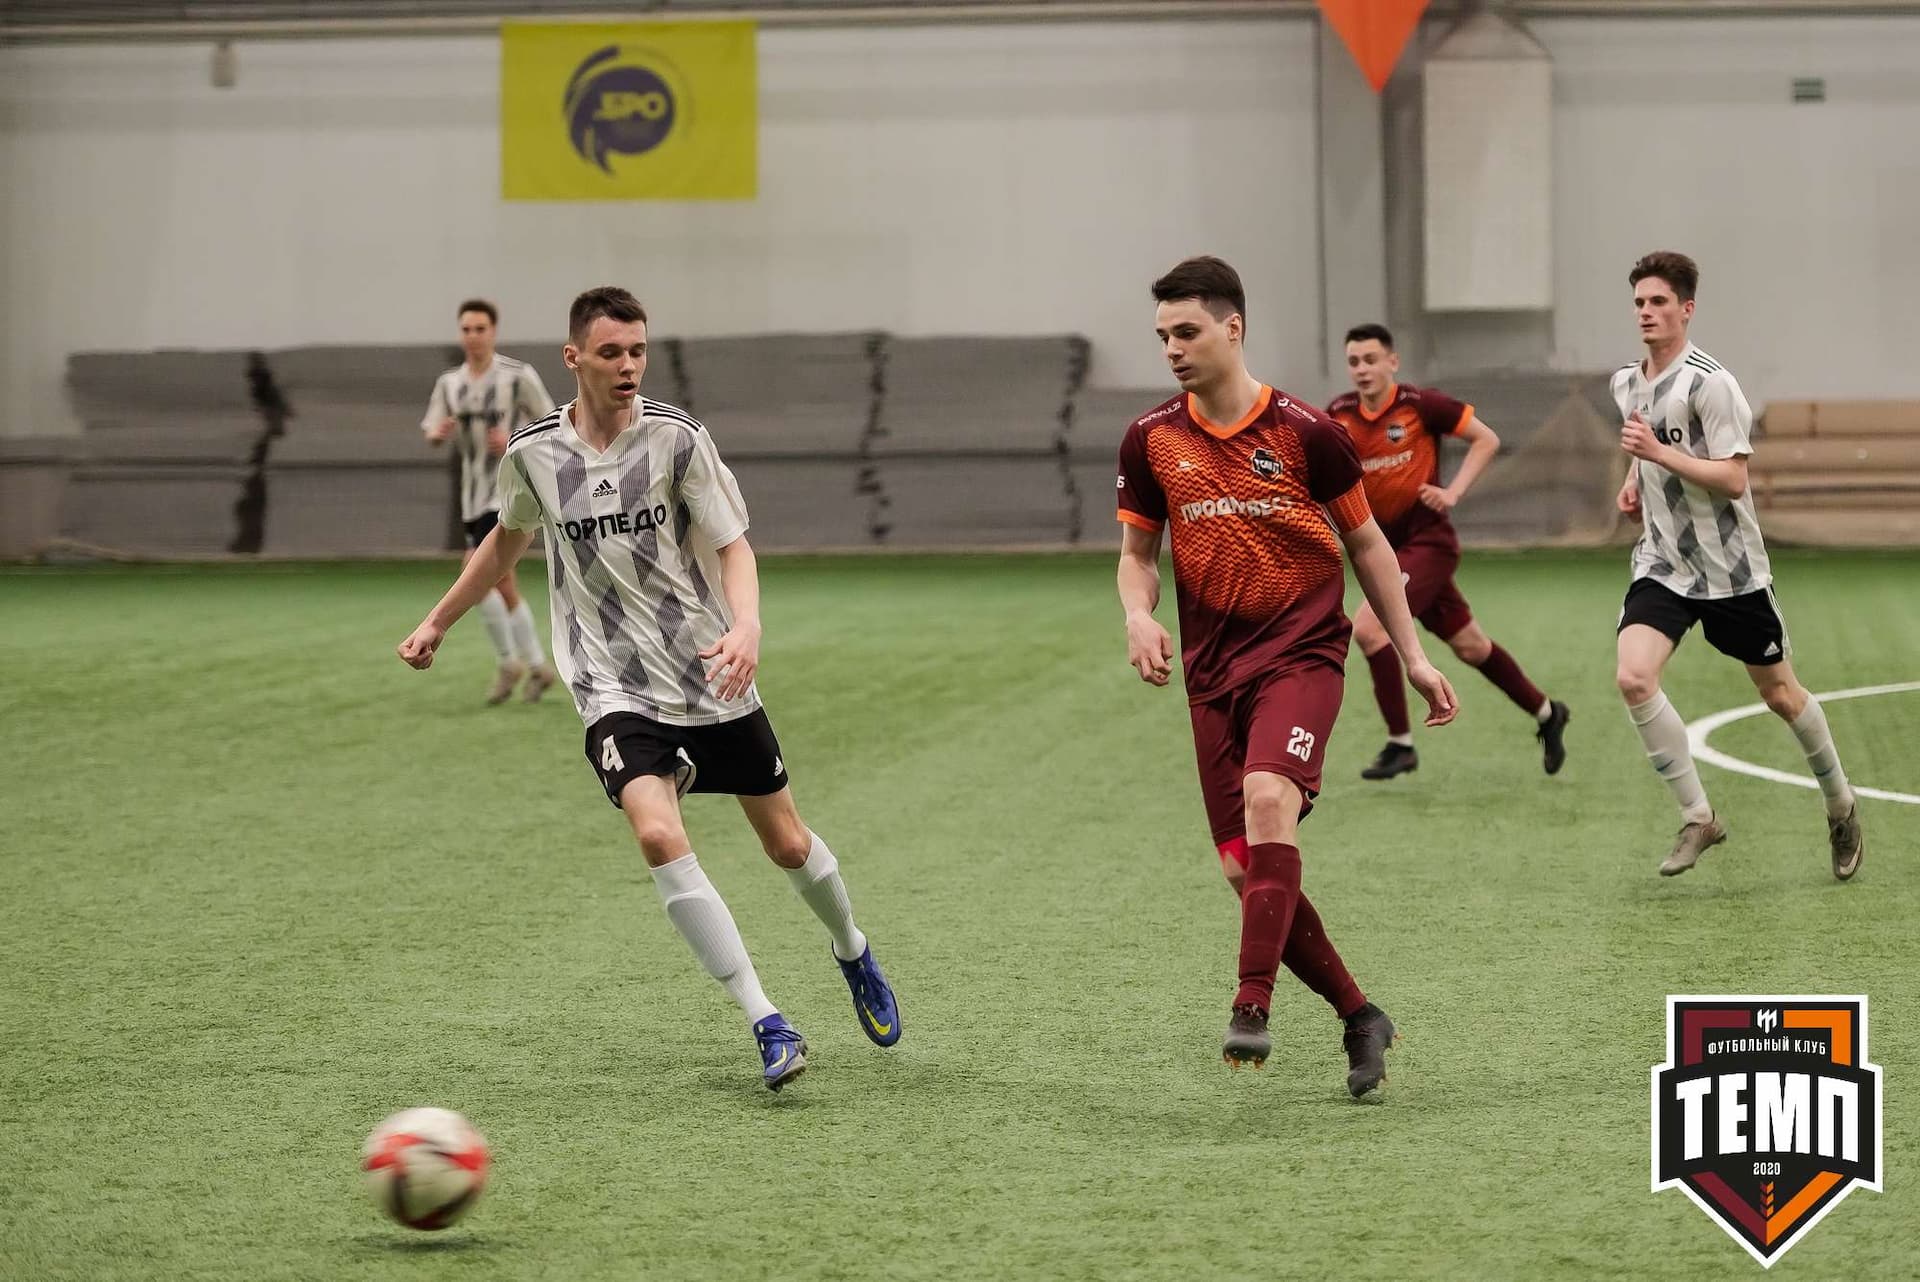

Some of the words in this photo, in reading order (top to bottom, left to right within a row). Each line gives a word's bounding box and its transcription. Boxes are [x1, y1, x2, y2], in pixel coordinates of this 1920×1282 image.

[556, 504, 667, 542] ТОРПЕДО
[601, 734, 626, 773] 4
[1286, 726, 1316, 763] 23
